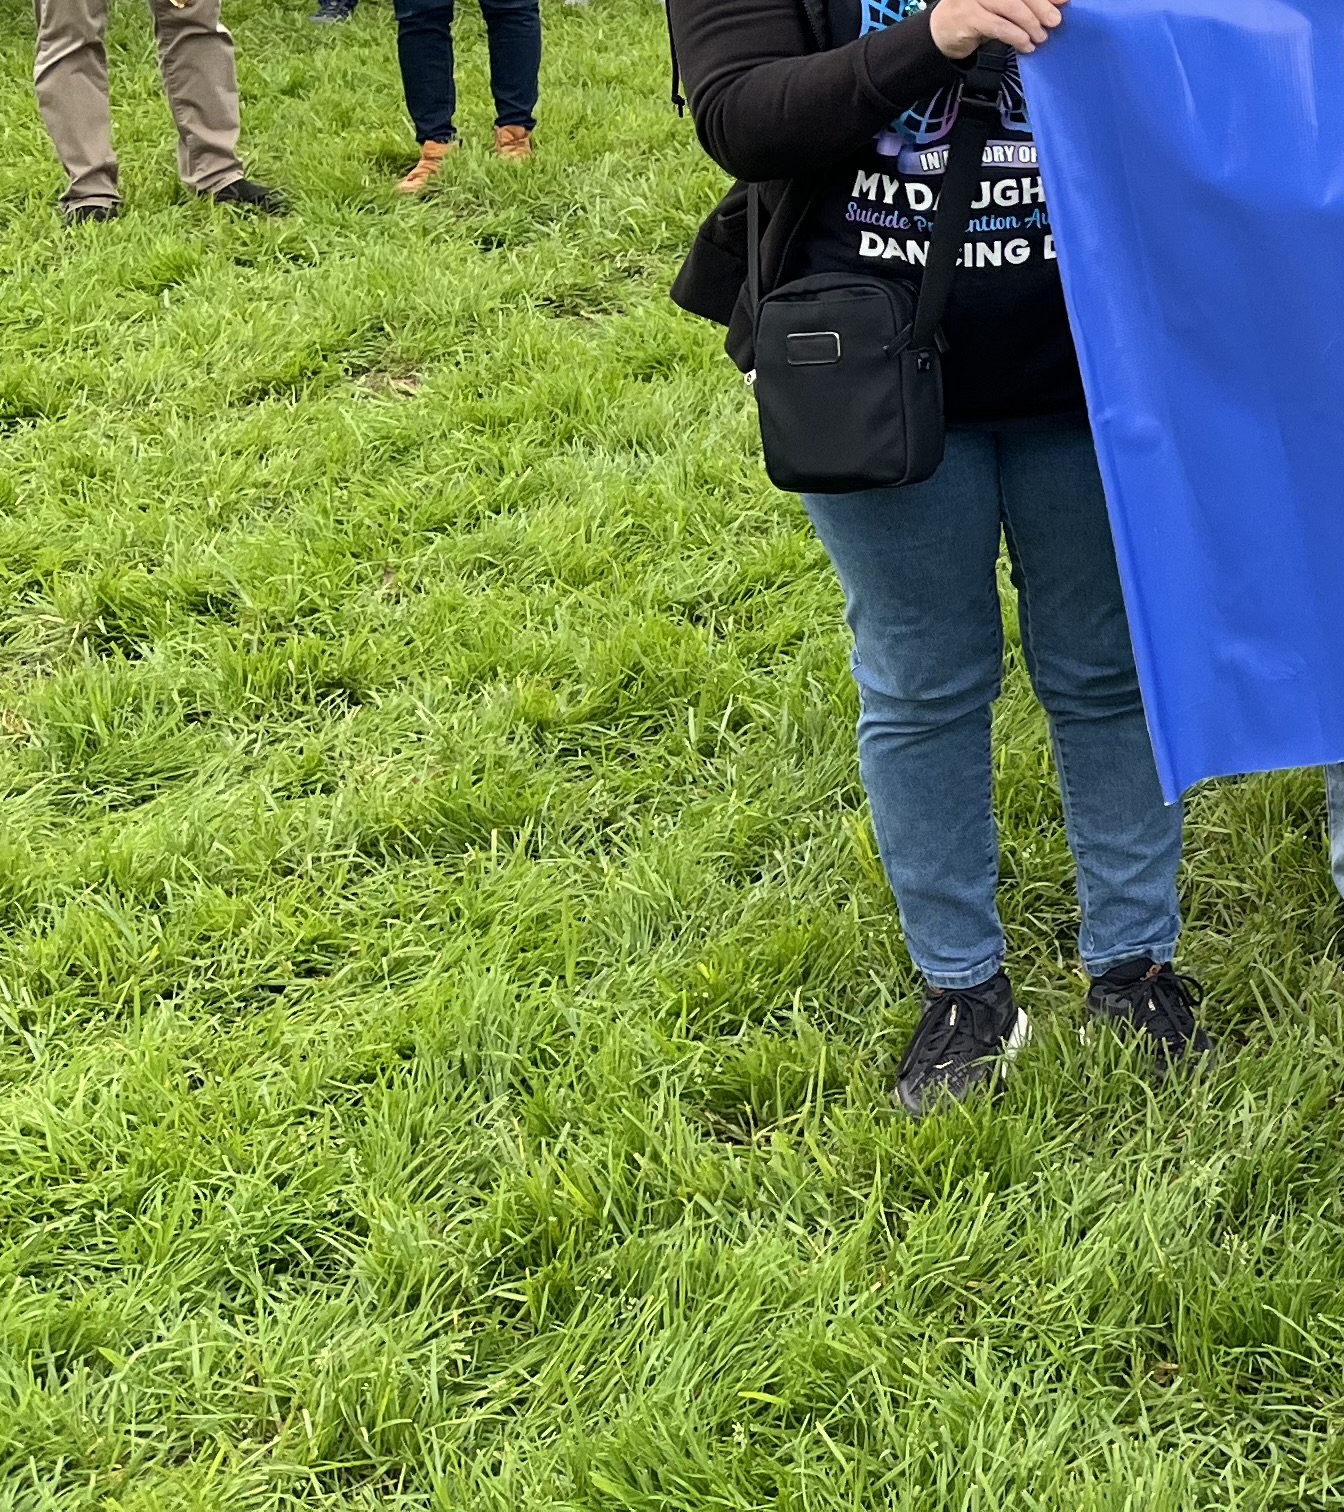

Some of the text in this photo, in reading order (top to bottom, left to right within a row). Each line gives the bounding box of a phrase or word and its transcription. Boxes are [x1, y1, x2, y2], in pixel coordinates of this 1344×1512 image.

[919, 151, 941, 171] IN
[851, 169, 900, 205] MY
[845, 201, 912, 231] Suicide
[859, 230, 1031, 268] DANING
